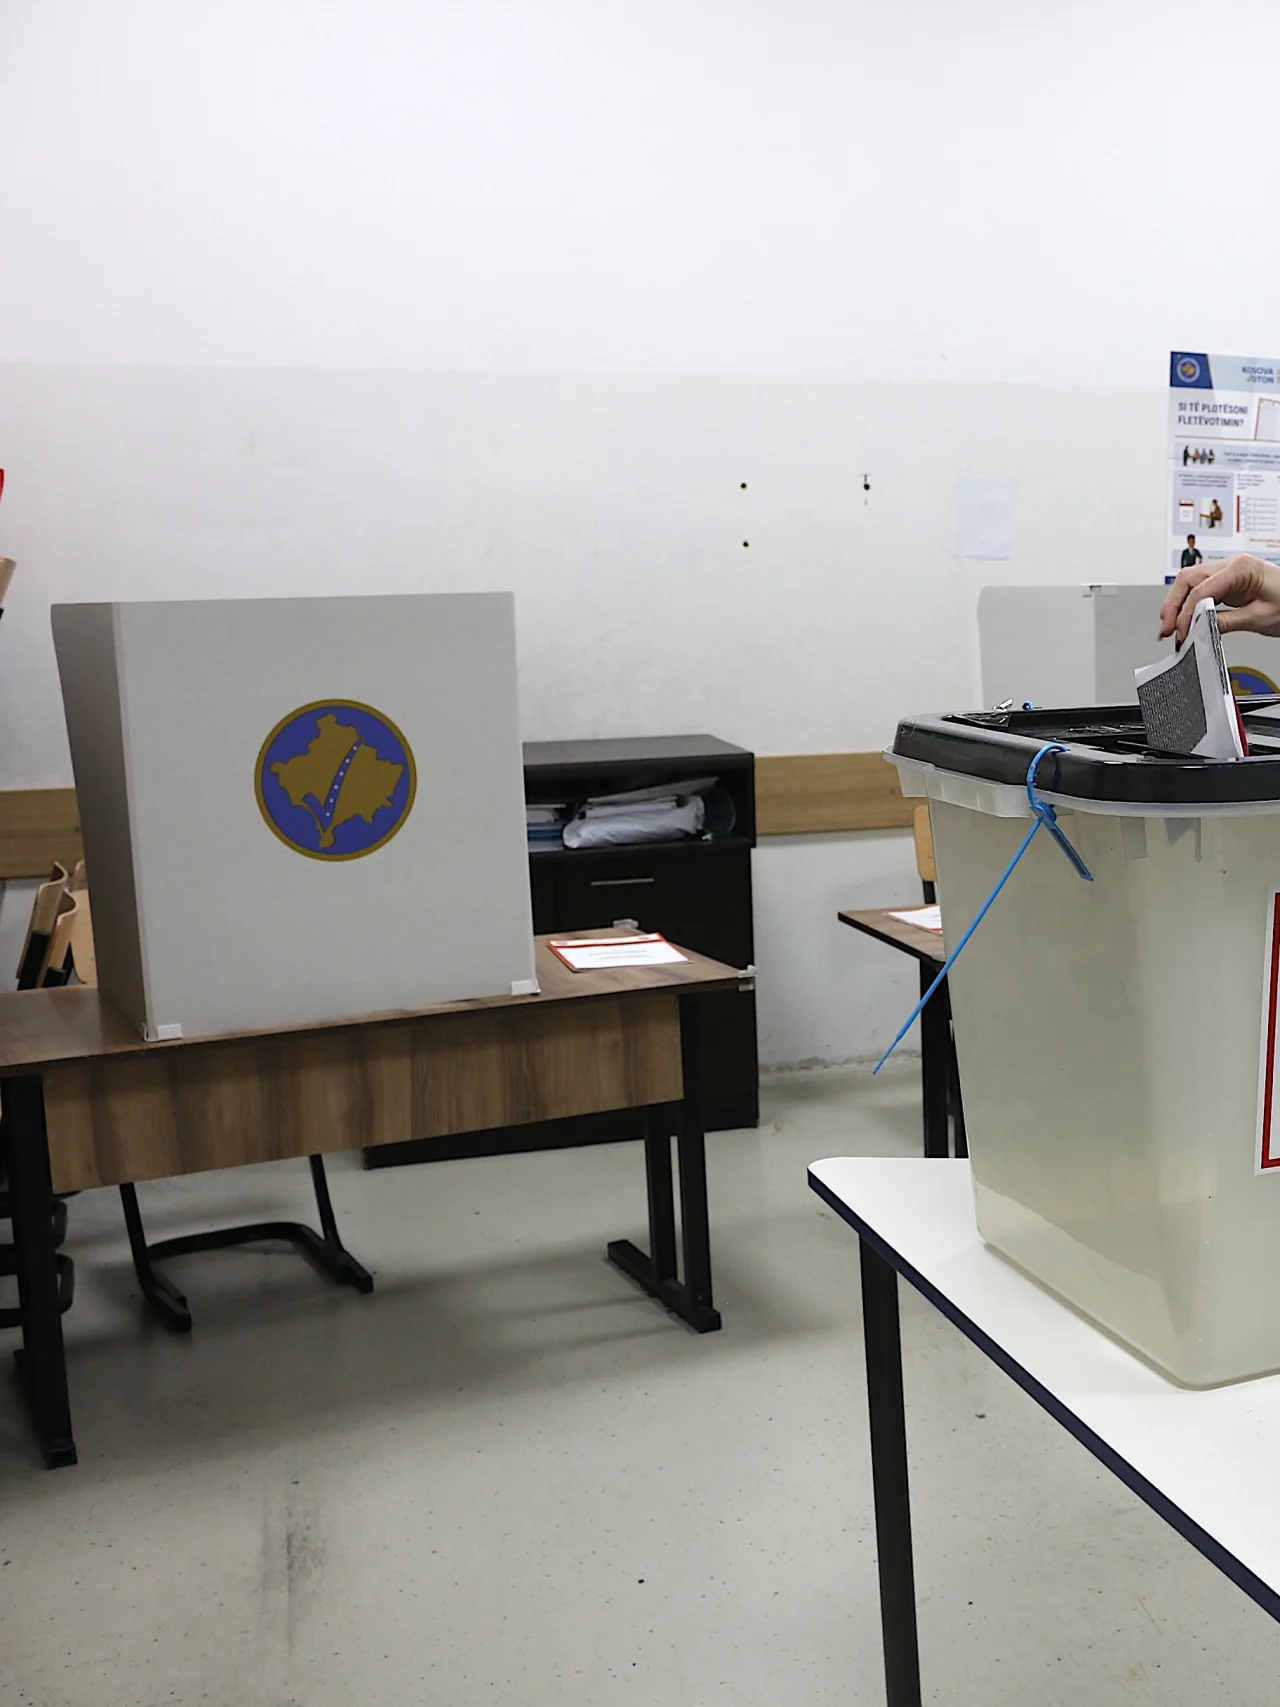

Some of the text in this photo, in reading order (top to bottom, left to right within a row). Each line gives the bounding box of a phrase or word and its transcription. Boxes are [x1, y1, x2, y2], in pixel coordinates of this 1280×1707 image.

[1242, 366, 1274, 375] KOSOVA
[1178, 401, 1248, 414] SI TË PLOTËSONI
[1177, 415, 1245, 427] FLETËVOTIMIN?
